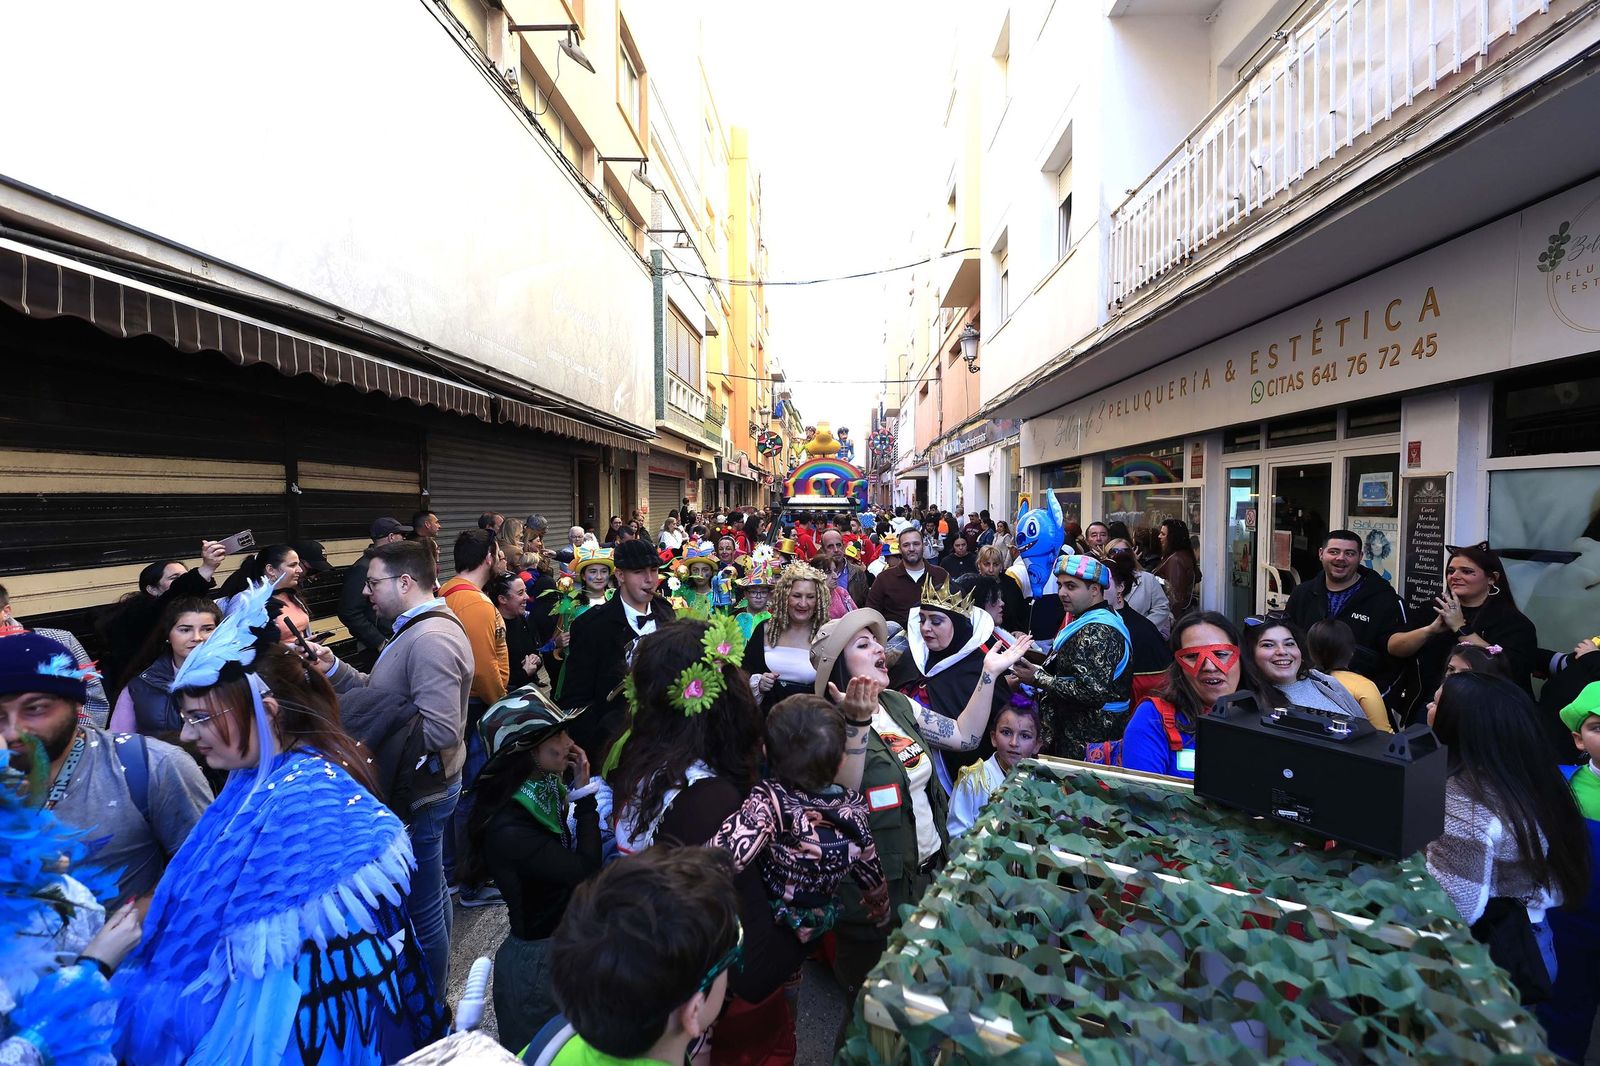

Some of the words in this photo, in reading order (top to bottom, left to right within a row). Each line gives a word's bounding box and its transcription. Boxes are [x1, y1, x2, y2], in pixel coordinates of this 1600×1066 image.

[1555, 264, 1594, 283] PELU
[1571, 277, 1600, 293] EST
[1225, 359, 1236, 383] &
[1250, 286, 1440, 375] ESTÉTICA
[1267, 371, 1304, 397] CITAS
[1312, 361, 1337, 386] 641
[1347, 353, 1368, 377] 76
[1379, 343, 1401, 369] 72
[1411, 333, 1438, 360] 45
